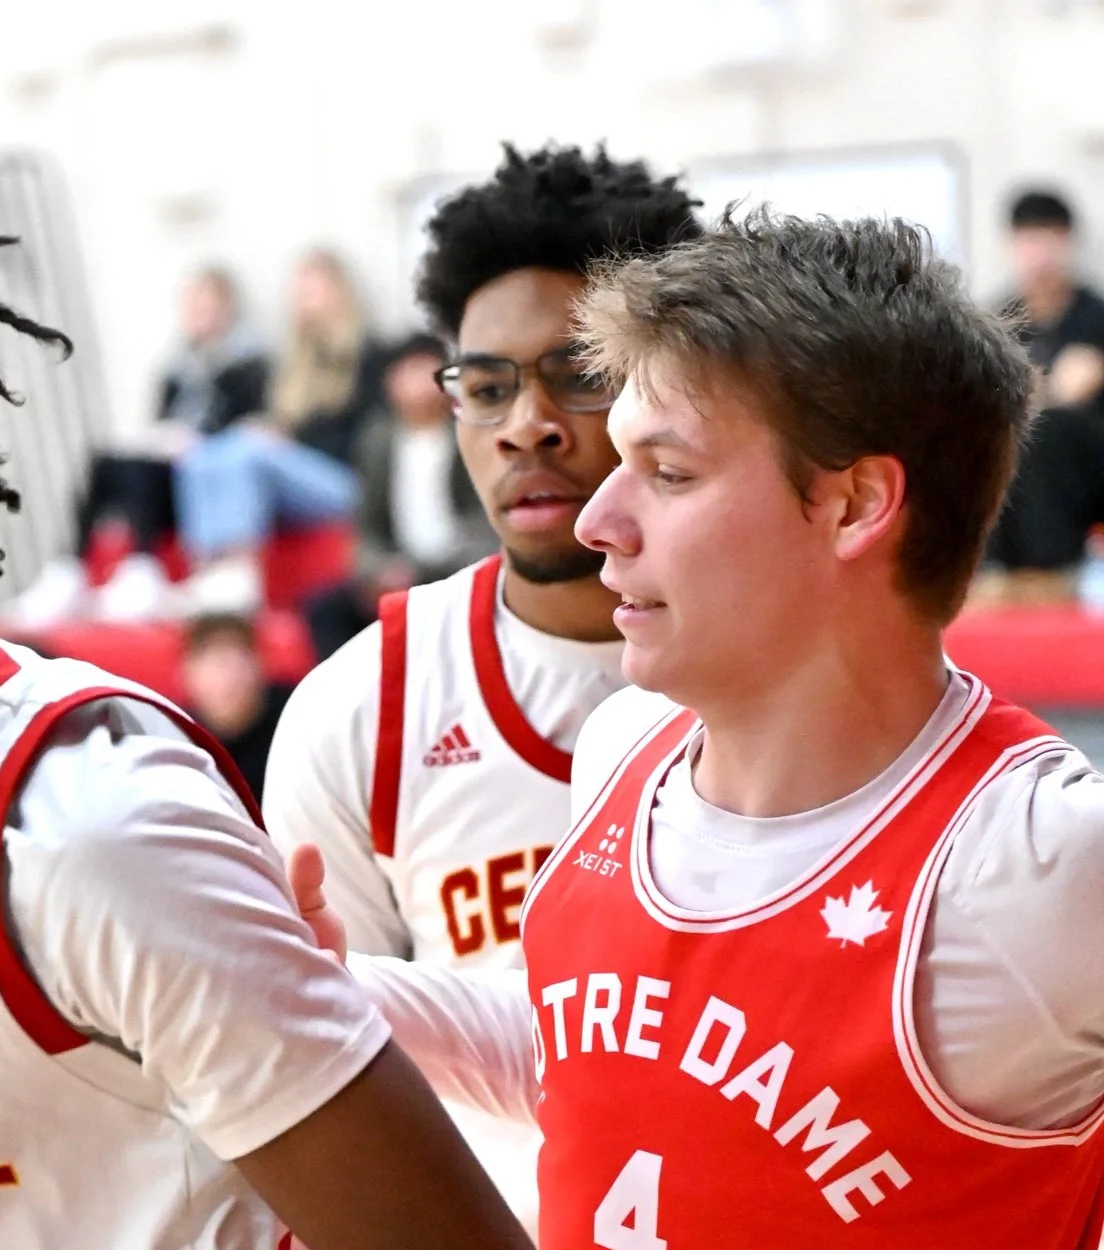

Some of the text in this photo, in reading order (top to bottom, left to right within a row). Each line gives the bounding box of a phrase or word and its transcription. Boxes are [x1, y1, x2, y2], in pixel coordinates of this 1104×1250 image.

[440, 845, 554, 957] CE
[572, 850, 622, 878] XEIST
[679, 996, 912, 1224] DAME
